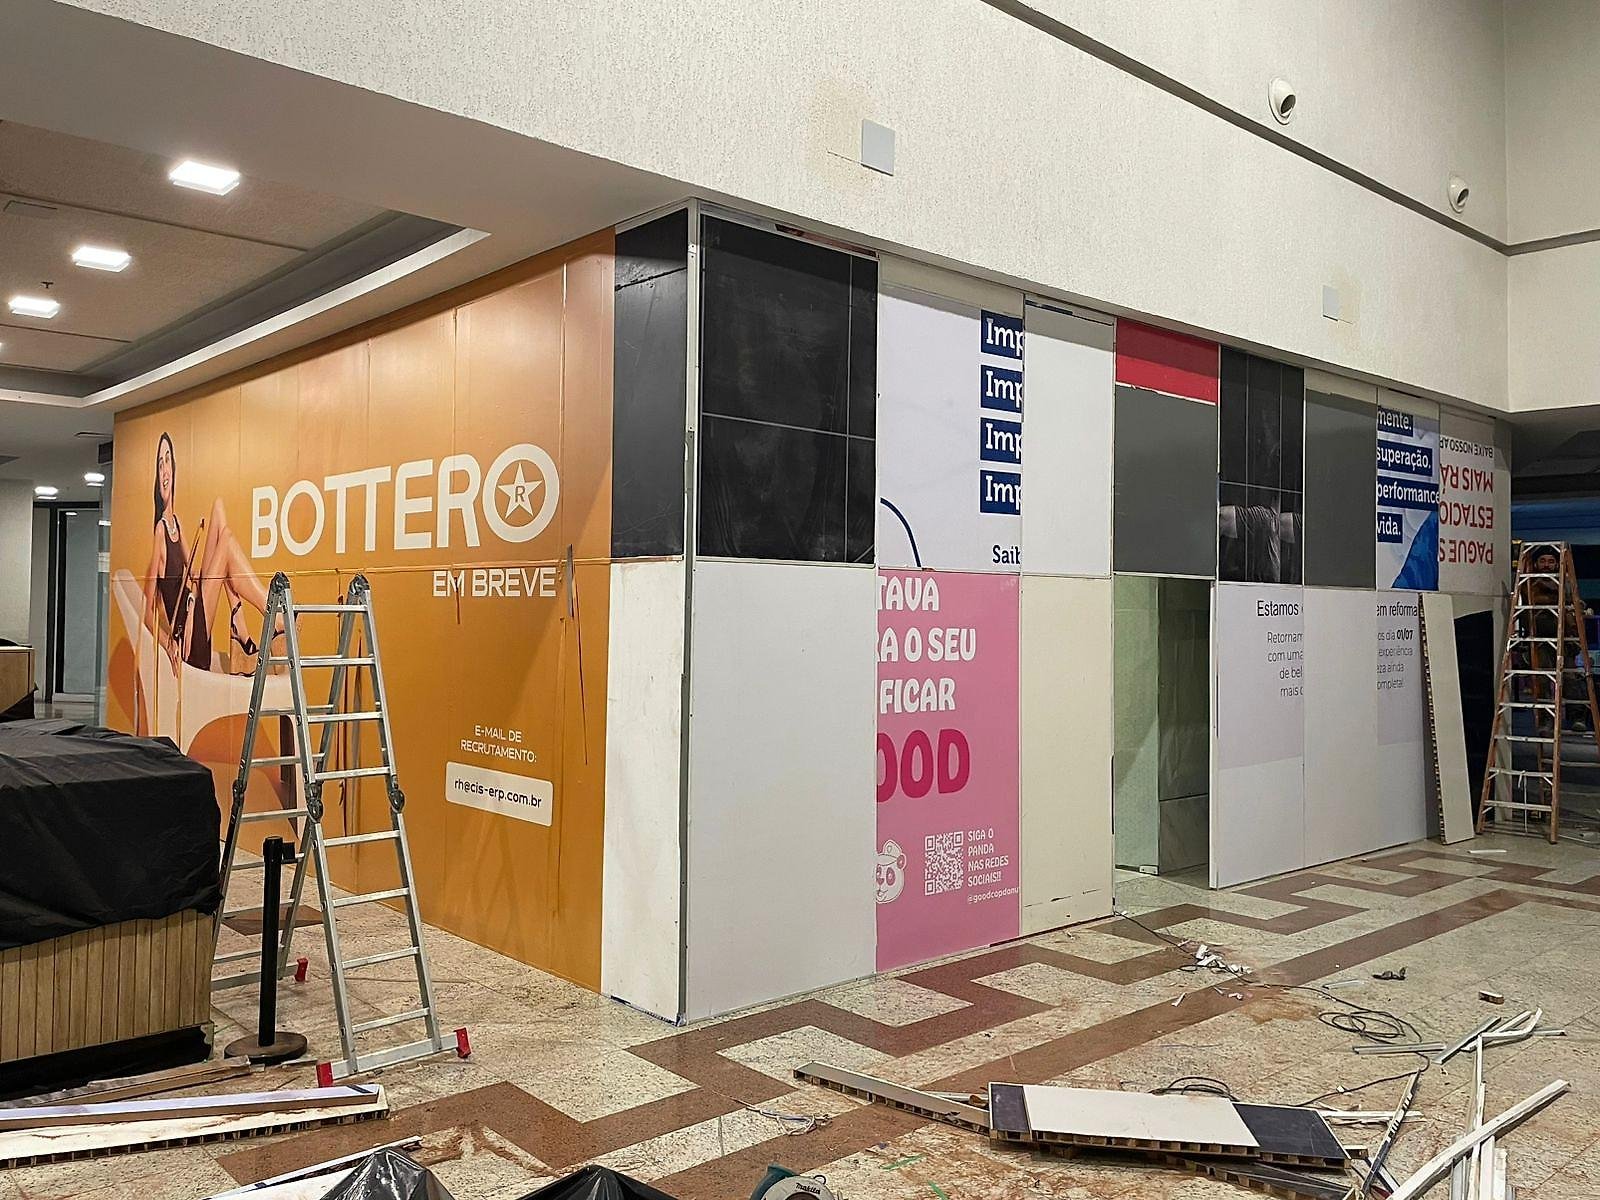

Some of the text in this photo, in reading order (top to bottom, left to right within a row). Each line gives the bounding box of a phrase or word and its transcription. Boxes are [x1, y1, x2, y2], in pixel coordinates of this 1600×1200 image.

[1450, 439, 1473, 453] NOSSO
[1474, 443, 1493, 458] BAIXE
[1377, 446, 1431, 471] superação.
[1439, 463, 1494, 494] MAIS RÁ
[251, 443, 560, 559] BOTTERO
[1377, 481, 1440, 504] performance
[1439, 500, 1494, 529] ESTACIO
[1448, 539, 1494, 565] PAGUE
[433, 567, 557, 597] EM BREVE
[1257, 600, 1299, 617] Estamos
[1389, 601, 1418, 617] reforma
[1396, 628, 1414, 641] 01/07
[904, 627, 922, 662] O
[927, 628, 977, 662] SEU
[1267, 651, 1285, 662] com
[1279, 667, 1290, 680] de
[880, 678, 956, 714] FICAR
[1280, 686, 1299, 698] mais
[475, 725, 522, 743] E-MAIL DE
[460, 739, 537, 763] RECRUTAMENTO:
[454, 779, 542, 809] rh@cis-erp.com.br
[968, 828, 994, 842] SIGA O
[968, 843, 994, 857] PANDA
[968, 855, 1009, 872] NAS REDES
[968, 887, 1020, 904] @goodcopdonu
